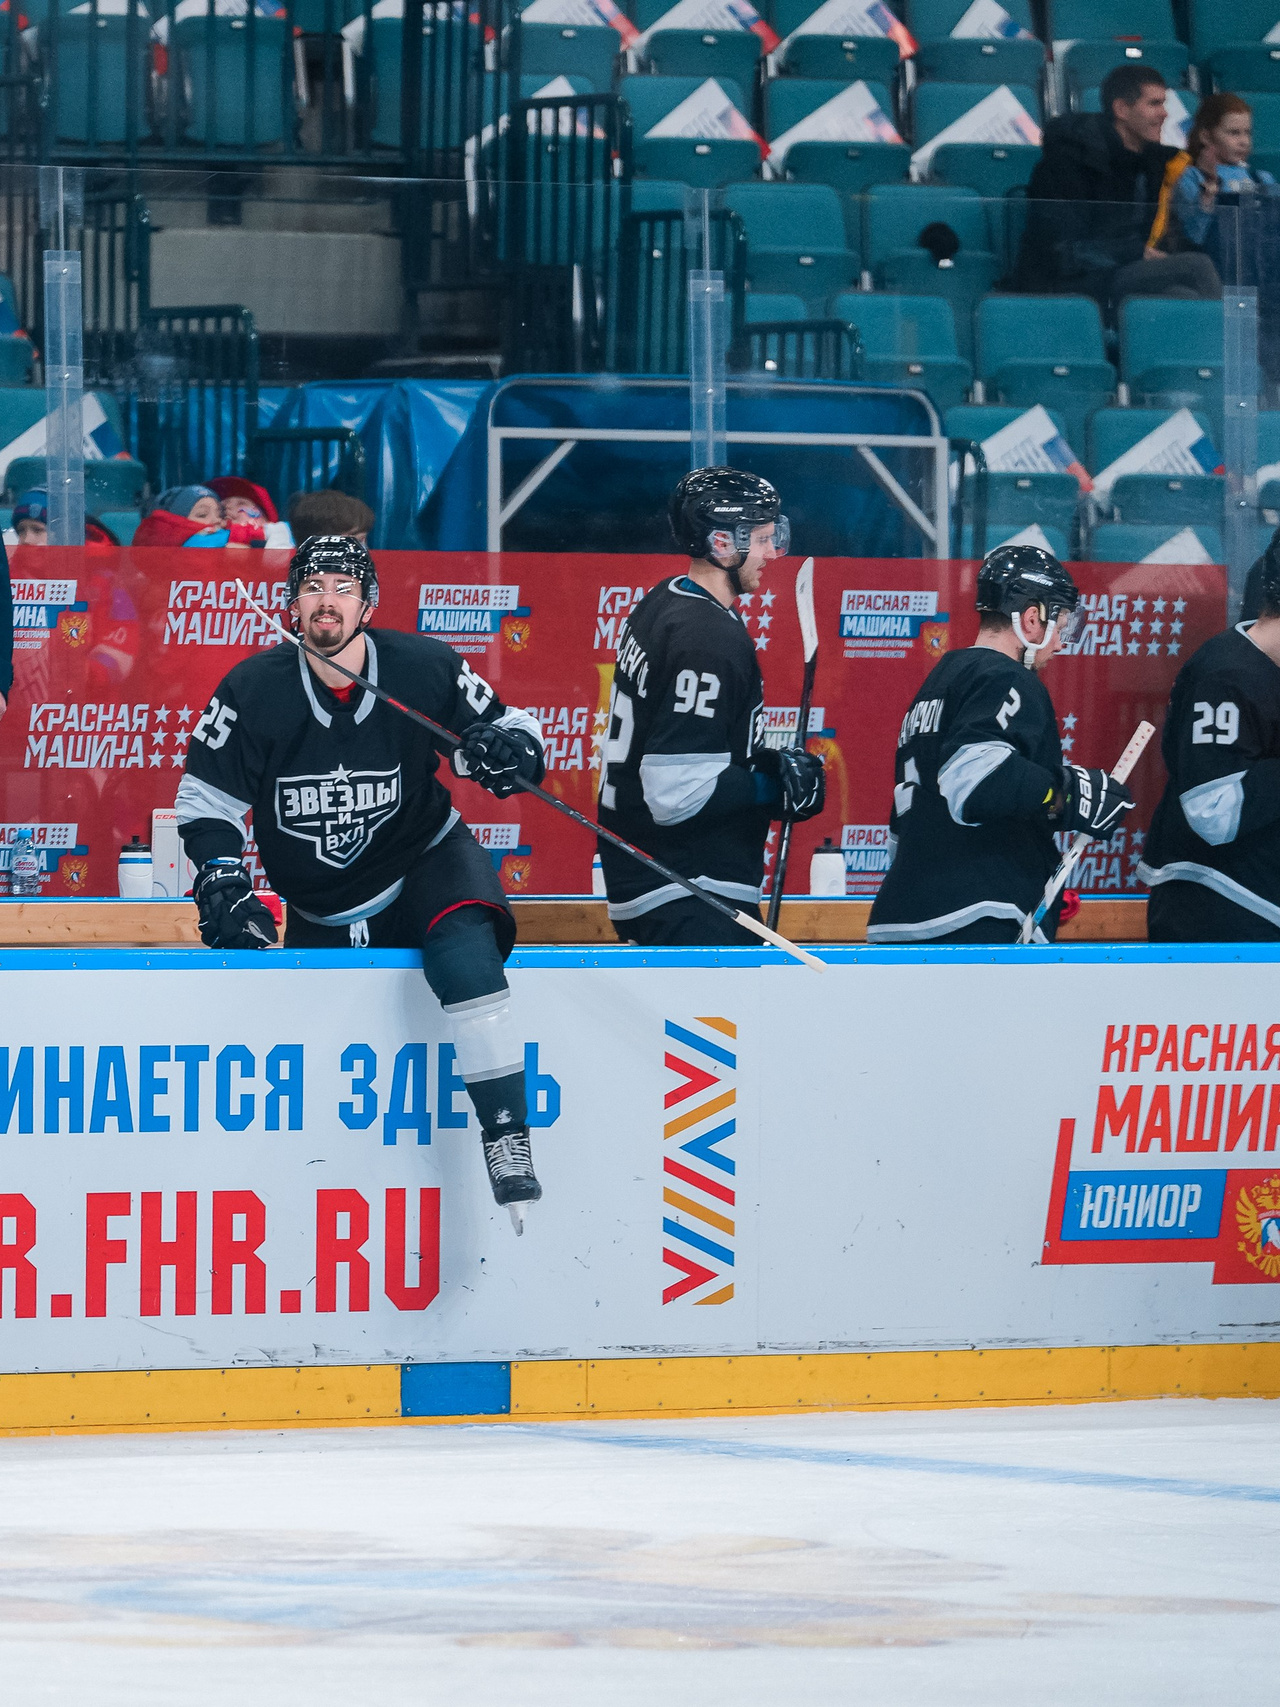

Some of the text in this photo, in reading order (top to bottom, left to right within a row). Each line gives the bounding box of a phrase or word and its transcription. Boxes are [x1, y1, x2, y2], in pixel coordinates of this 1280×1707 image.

[714, 505, 743, 513] BAUER
[168, 580, 287, 610] КРАСНАЯ
[424, 588, 491, 606] КРАСНАЯ
[598, 586, 654, 614] КРА
[846, 594, 910, 611] КРАСНАЯ
[163, 611, 285, 646] МАШИНА
[421, 610, 491, 632] МАШИНА
[842, 615, 911, 637] МАШИНА
[673, 669, 721, 719] 92
[995, 686, 1021, 731] 2
[27, 703, 150, 733] КРАСНАЯ
[191, 697, 238, 750] 25
[1192, 701, 1240, 745] 29
[23, 734, 145, 770] МАШИНА
[283, 776, 399, 818] ЗВЁЗДЫ
[337, 812, 353, 824] И
[325, 824, 365, 852] ВХЛ
[338, 1042, 561, 1146] ЗДЕЬ
[1079, 1183, 1203, 1230] ЮНИОР
